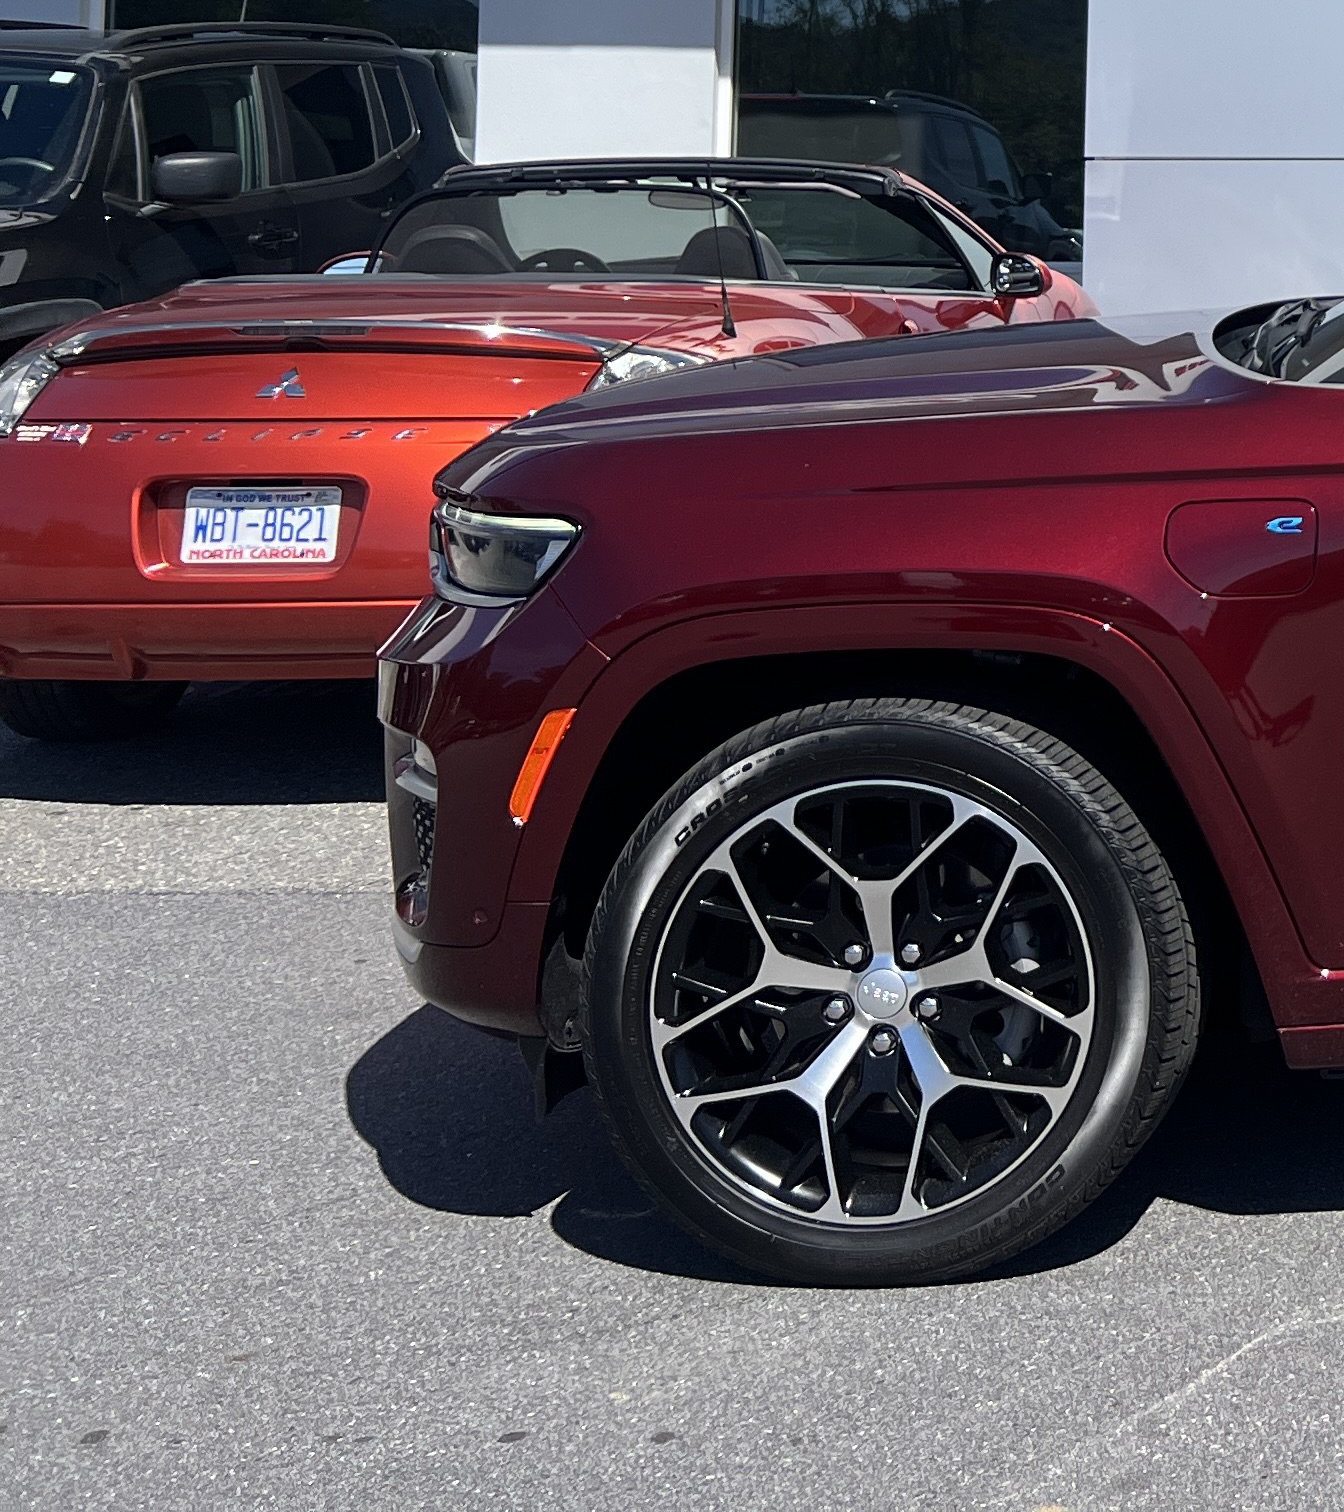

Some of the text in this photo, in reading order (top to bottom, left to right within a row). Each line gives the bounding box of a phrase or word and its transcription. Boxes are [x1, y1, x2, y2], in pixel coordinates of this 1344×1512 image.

[193, 505, 328, 544] WBT-8621
[187, 547, 327, 560] NORTH CAROLINA
